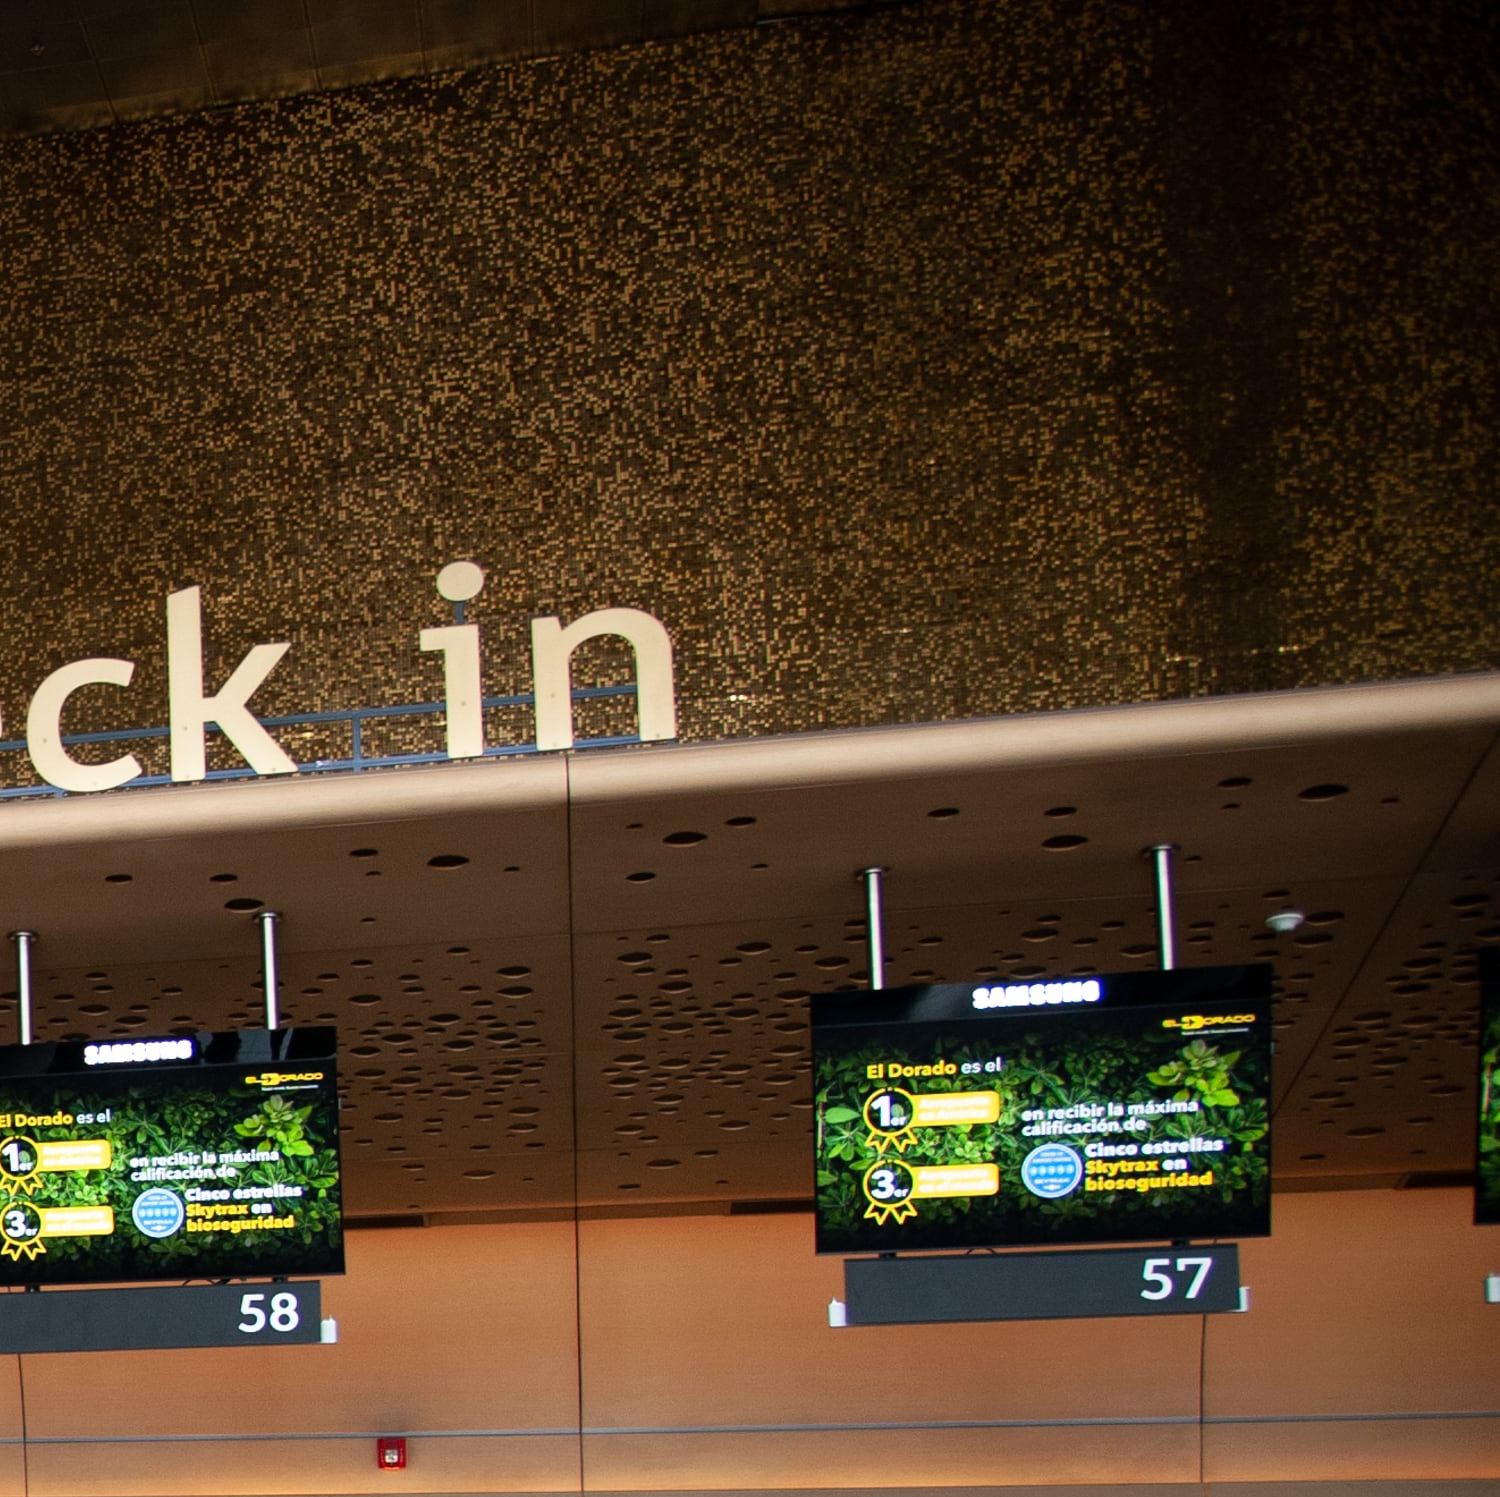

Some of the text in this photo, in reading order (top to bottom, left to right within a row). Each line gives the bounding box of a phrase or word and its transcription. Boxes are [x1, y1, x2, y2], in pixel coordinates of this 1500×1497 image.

[419, 561, 677, 758] in
[867, 1056, 1002, 1079] El Dorado es el
[15, 1111, 73, 1127] Dorado
[76, 1114, 93, 1124] es
[97, 1108, 111, 1123] el
[1022, 1100, 1199, 1121] en recibir la máxima
[1021, 1117, 1148, 1136] calificación de
[1085, 1138, 1224, 1158] Cinco estrellas
[129, 1150, 279, 1168] en recibir la máxima
[1085, 1159, 1159, 1176] Skytrax
[1162, 1159, 1187, 1171] en
[131, 1165, 236, 1181] calificación de
[1085, 1171, 1213, 1192] bioseguridad
[184, 1185, 302, 1201] Cinco estrellas
[186, 1203, 272, 1219] Skytrax en
[186, 1215, 295, 1233] bioseguridad
[1140, 1257, 1213, 1300] 57
[238, 1292, 299, 1333] 58
